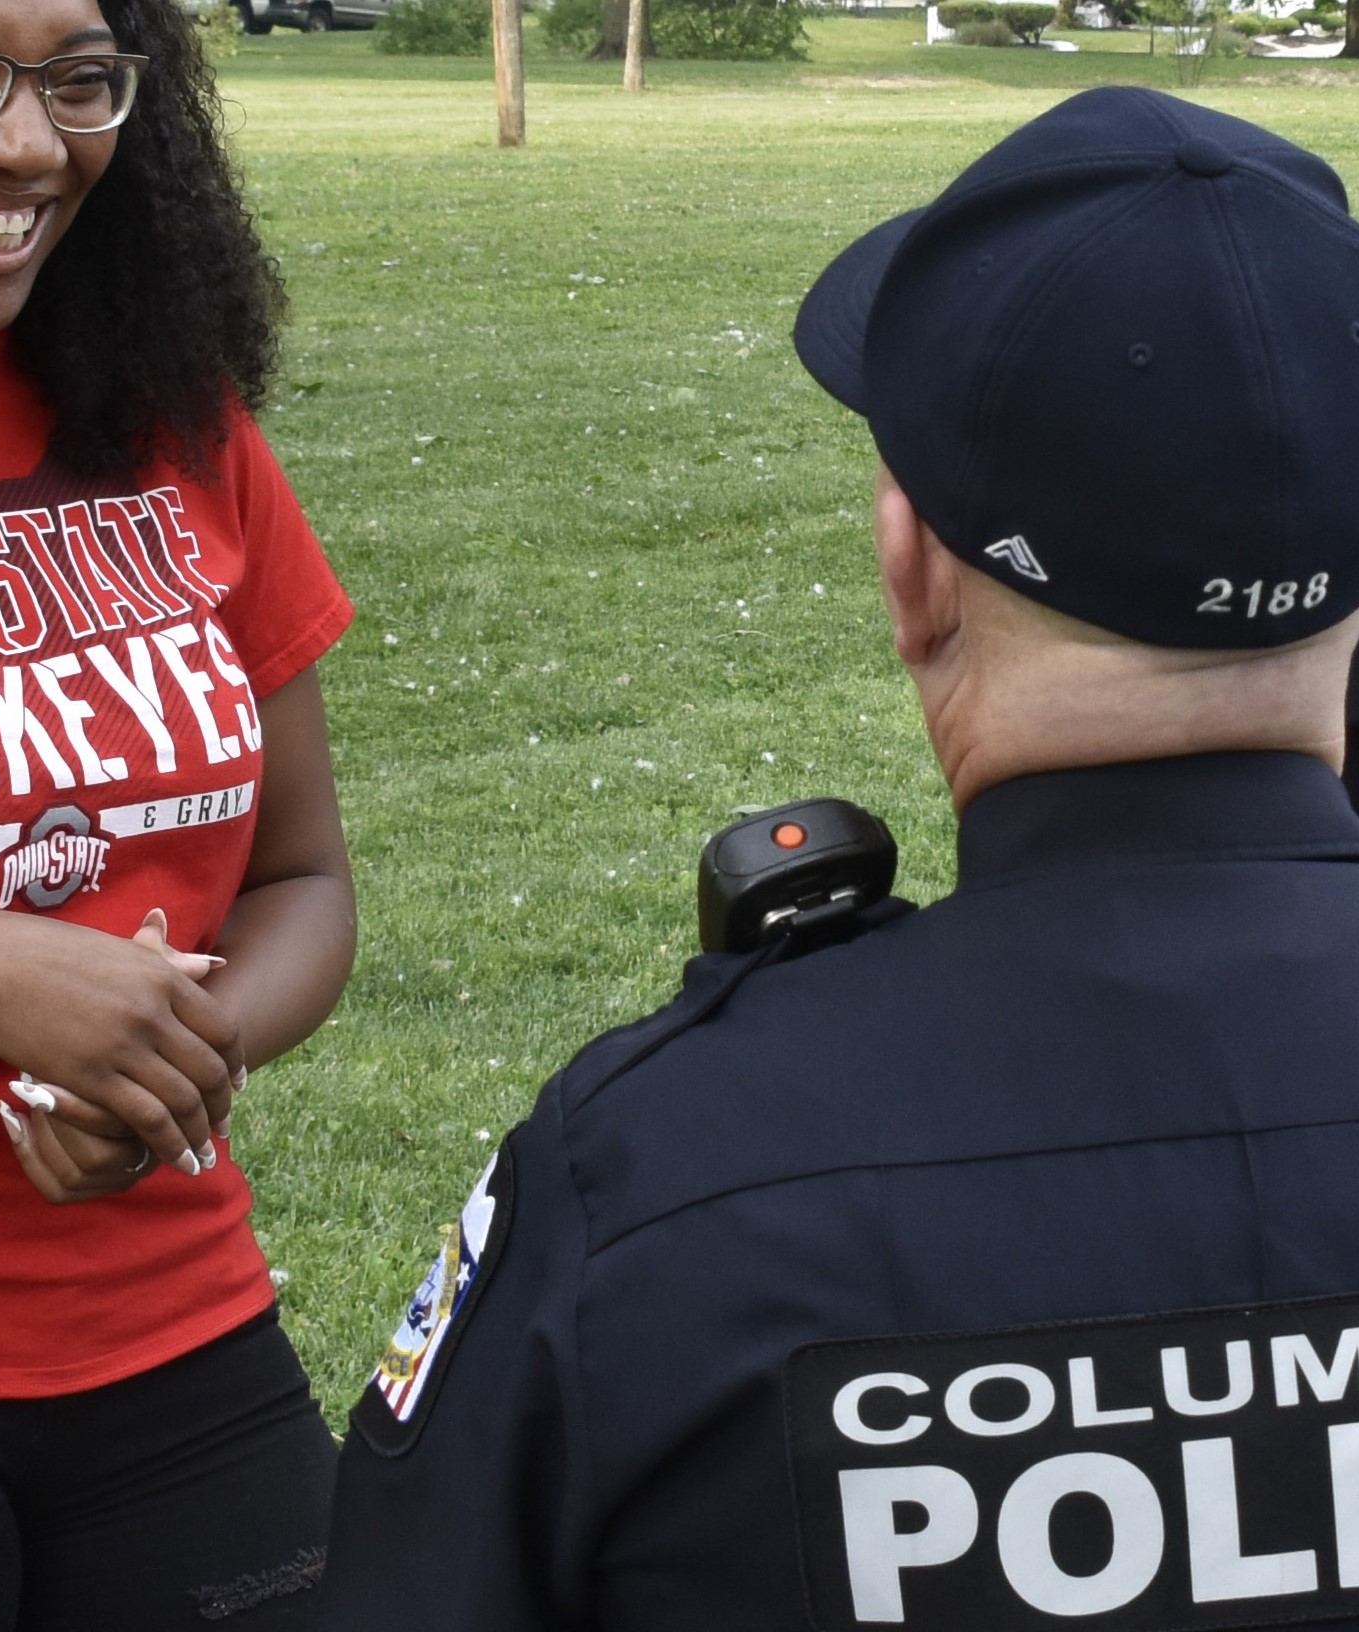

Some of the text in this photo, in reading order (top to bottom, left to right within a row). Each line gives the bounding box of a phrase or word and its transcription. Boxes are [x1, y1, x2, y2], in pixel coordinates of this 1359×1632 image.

[1197, 572, 1329, 618] 2188
[143, 805, 157, 829] &
[176, 787, 243, 825] GRAY
